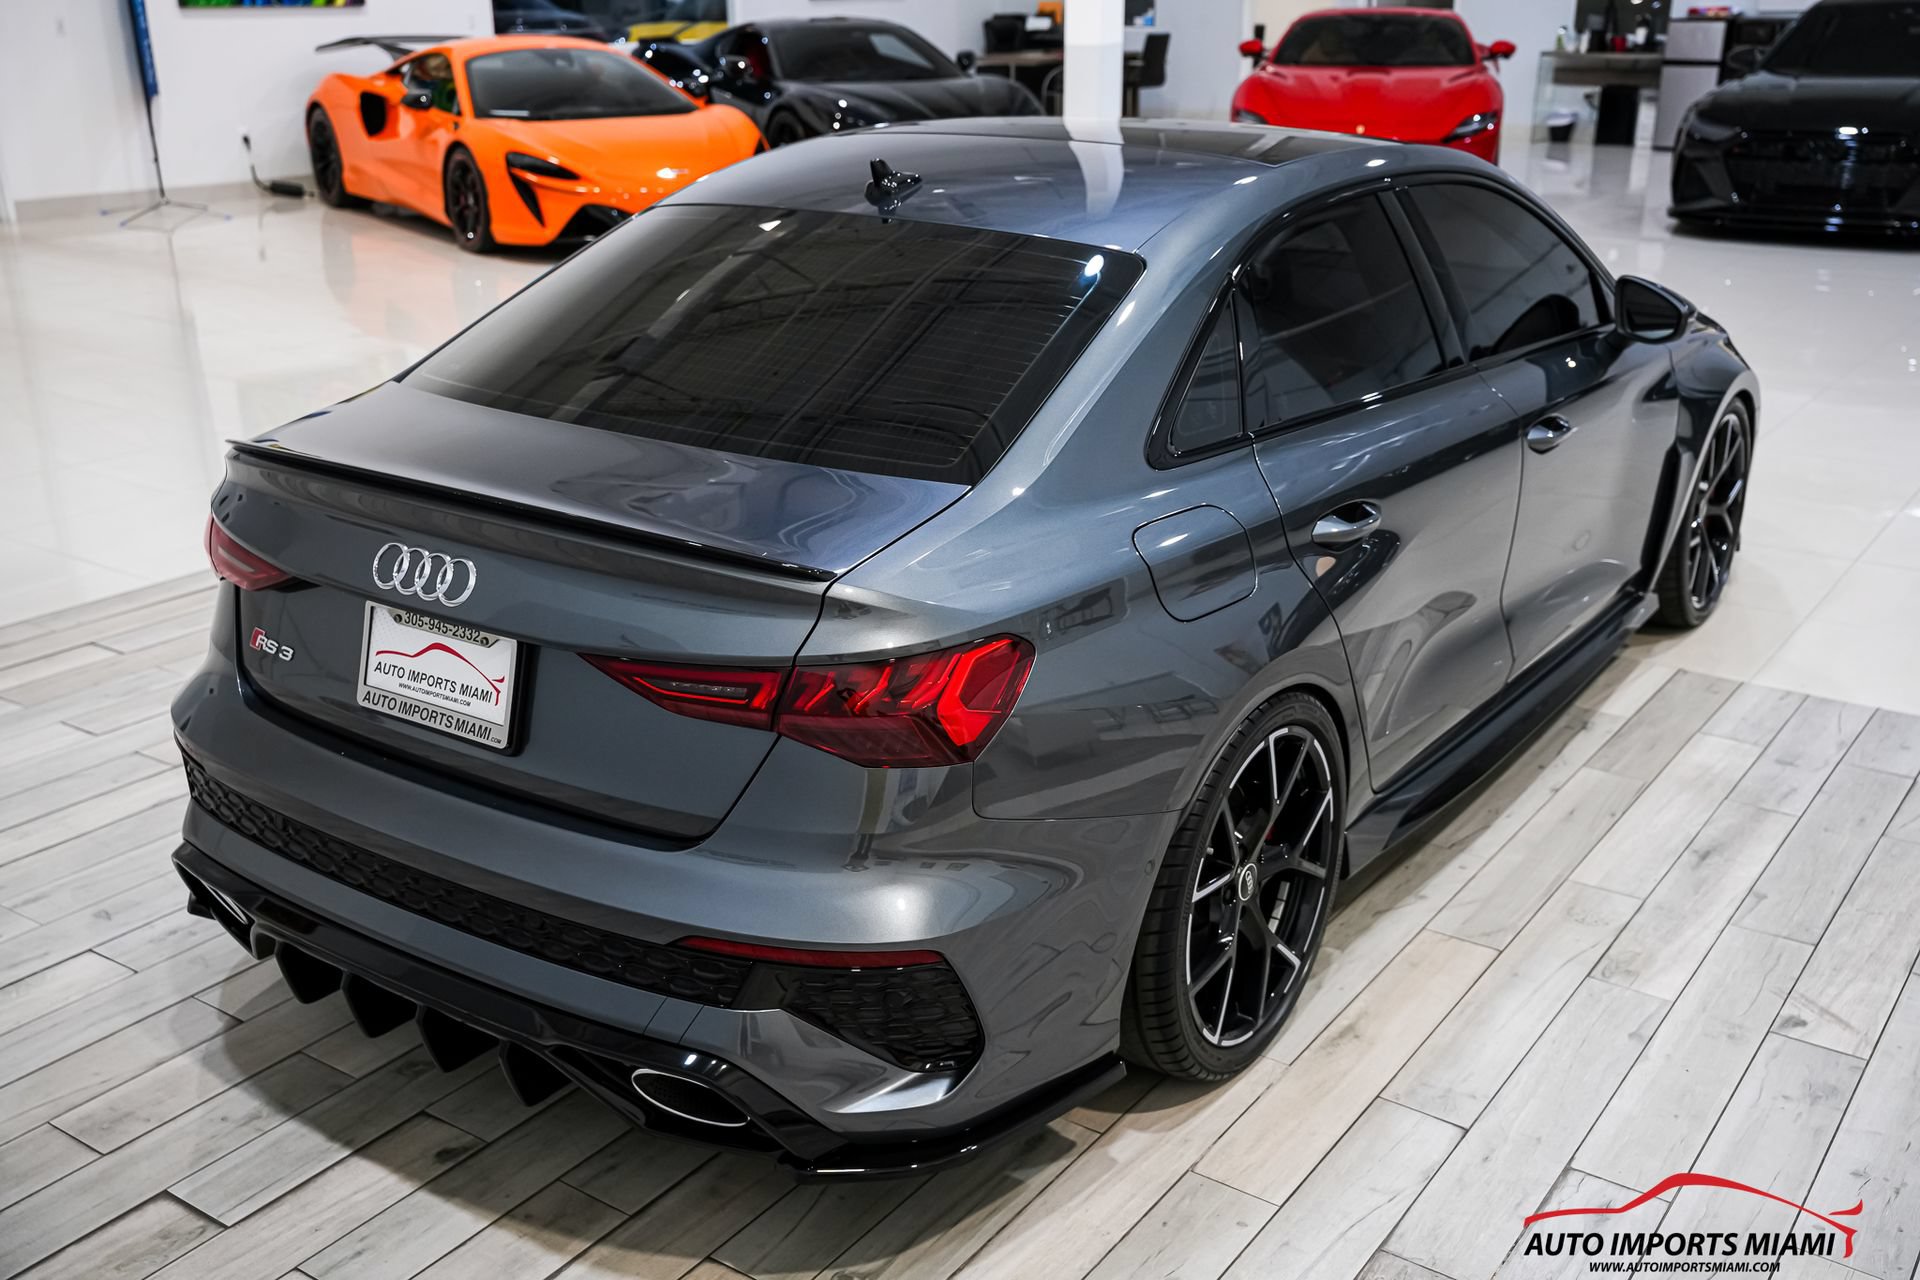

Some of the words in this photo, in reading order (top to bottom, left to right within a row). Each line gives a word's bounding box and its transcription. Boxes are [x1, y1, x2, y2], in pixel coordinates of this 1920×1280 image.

[404, 612, 480, 643] 305-945-2332
[374, 661, 405, 679] AUTO
[407, 669, 457, 693] IMPORTS
[459, 683, 493, 703] MIAMI
[362, 690, 397, 710] AUTO
[398, 700, 454, 729] IMPORTS
